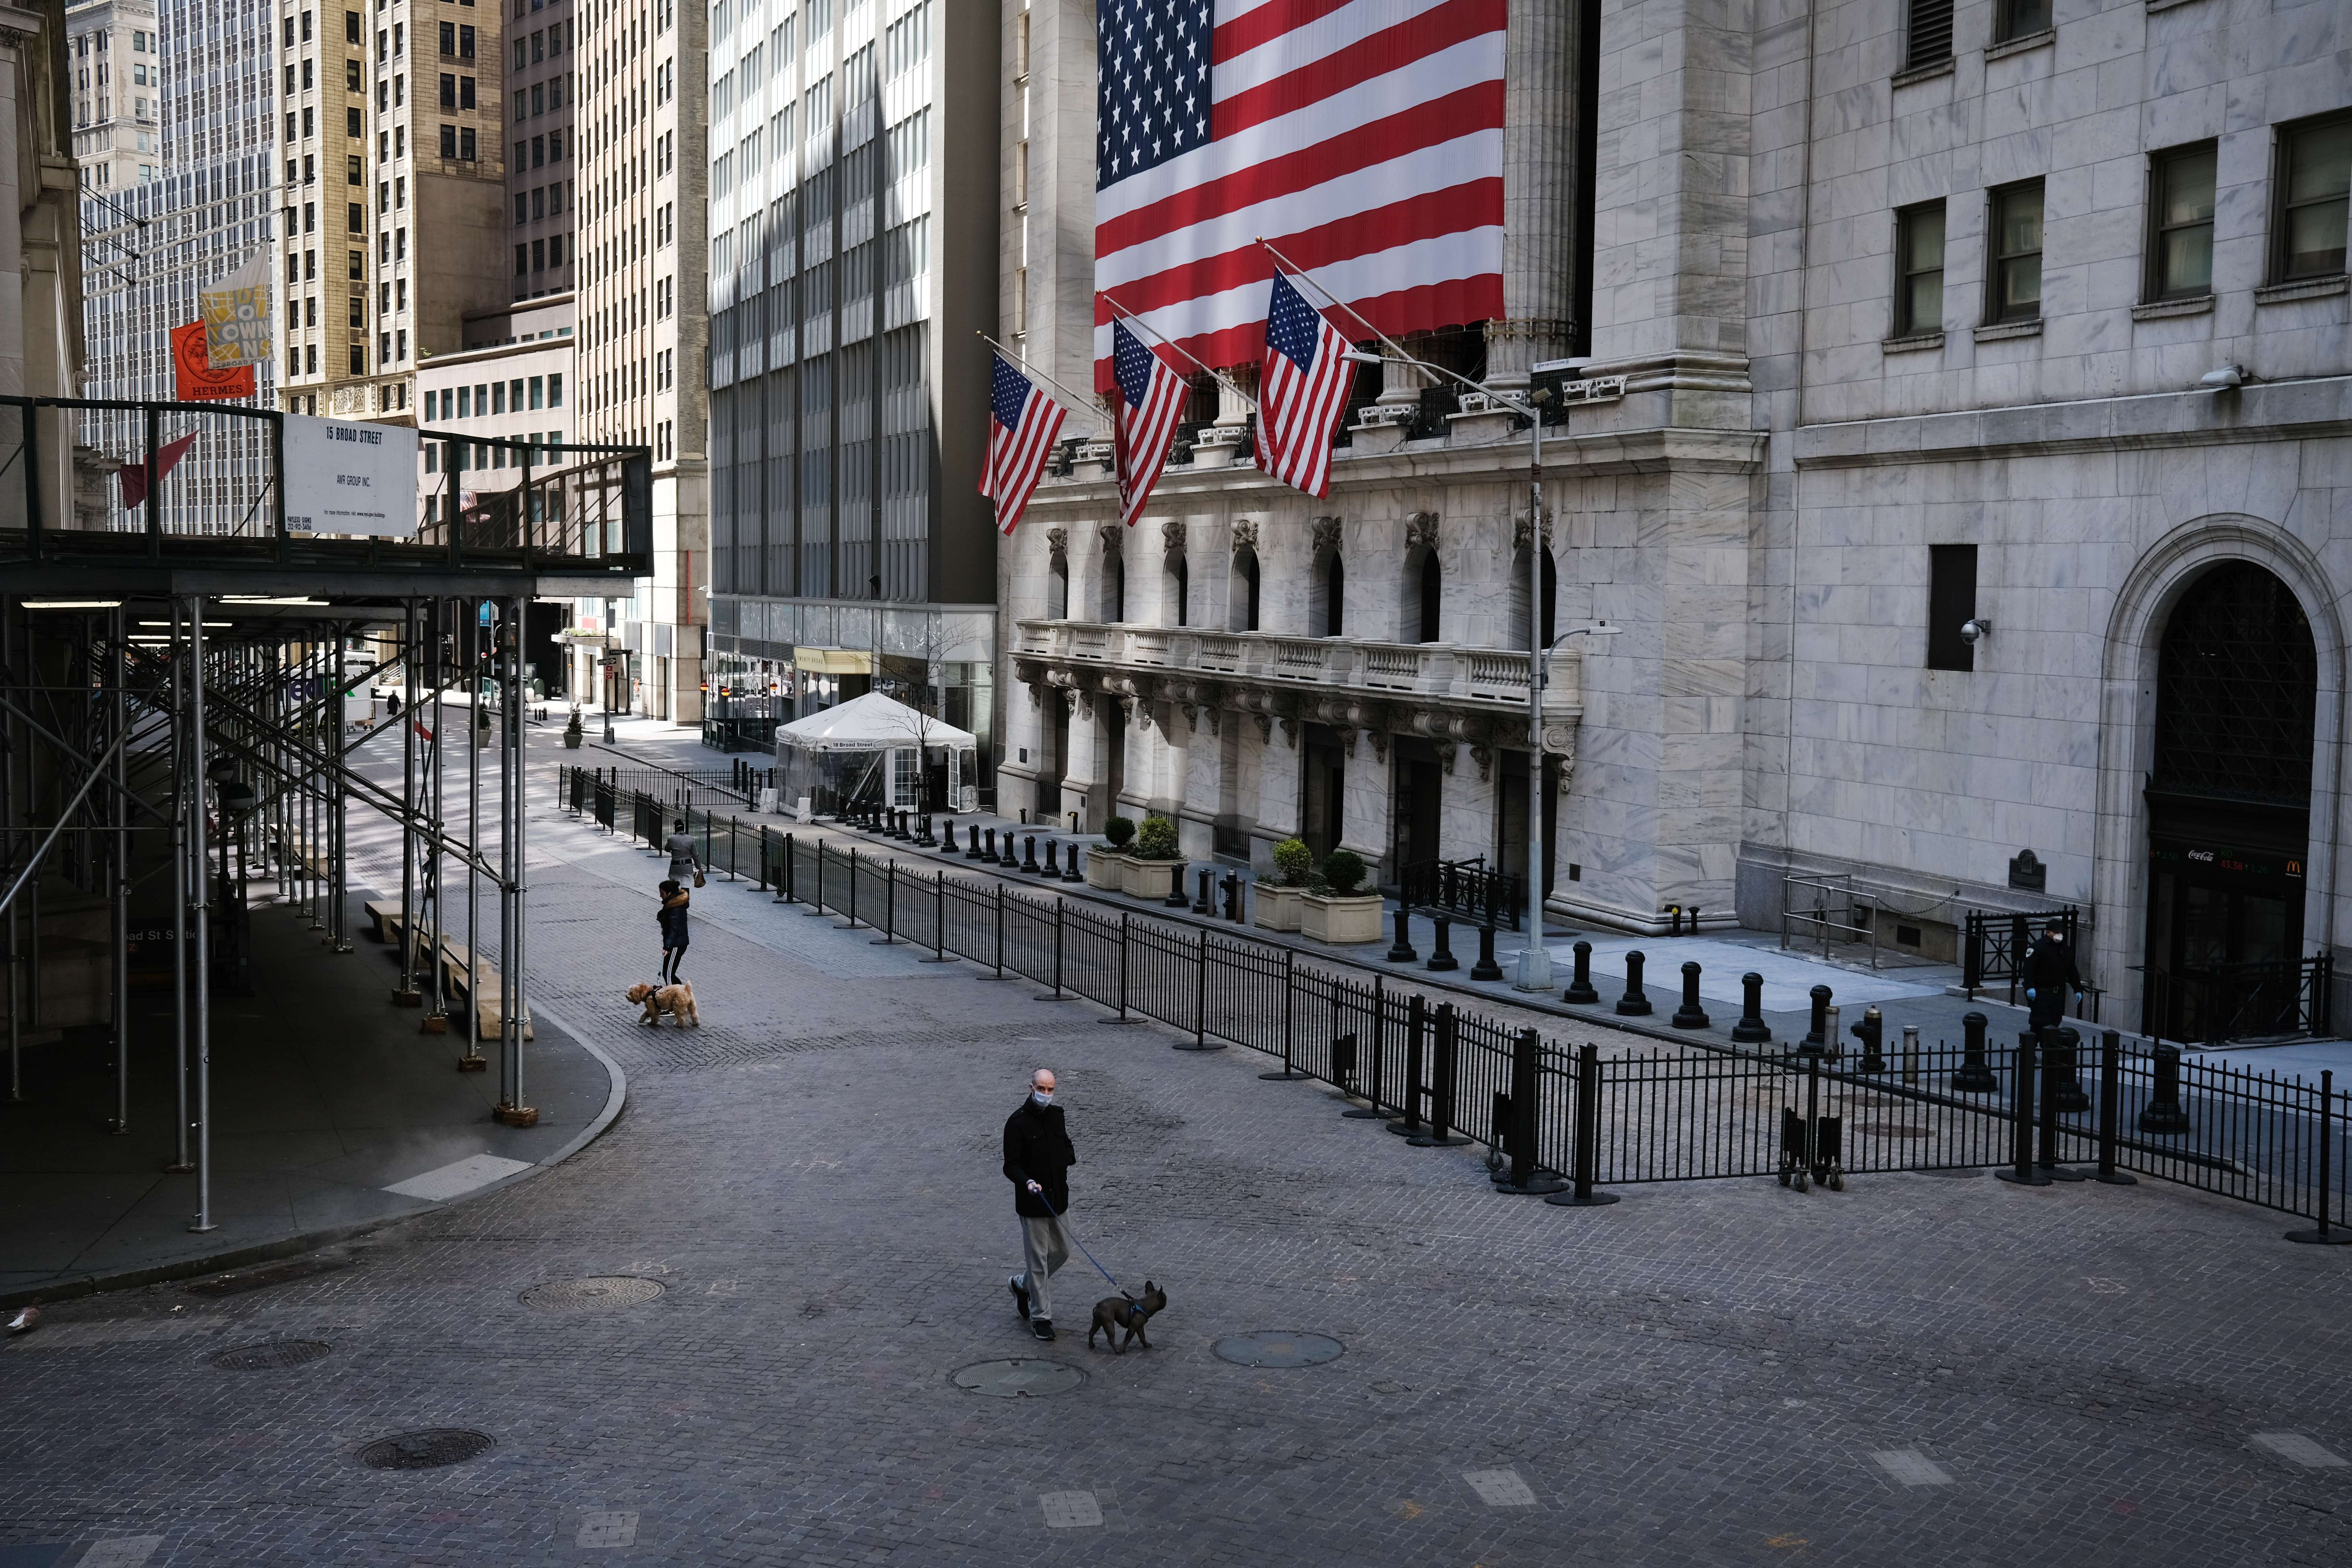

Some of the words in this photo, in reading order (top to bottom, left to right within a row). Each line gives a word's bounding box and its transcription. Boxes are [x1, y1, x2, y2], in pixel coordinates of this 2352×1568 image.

[222, 360, 248, 368] BROAD
[193, 384, 243, 396] HERMES
[326, 426, 333, 440] 15
[336, 428, 357, 442] BROAD
[360, 430, 382, 445] STREET
[337, 475, 345, 484] AWR
[347, 476, 360, 486] GROUP
[362, 478, 371, 487] INC.
[2221, 850, 2233, 858] KO
[2221, 860, 2243, 871] 43.38
[148, 931, 161, 940] St
